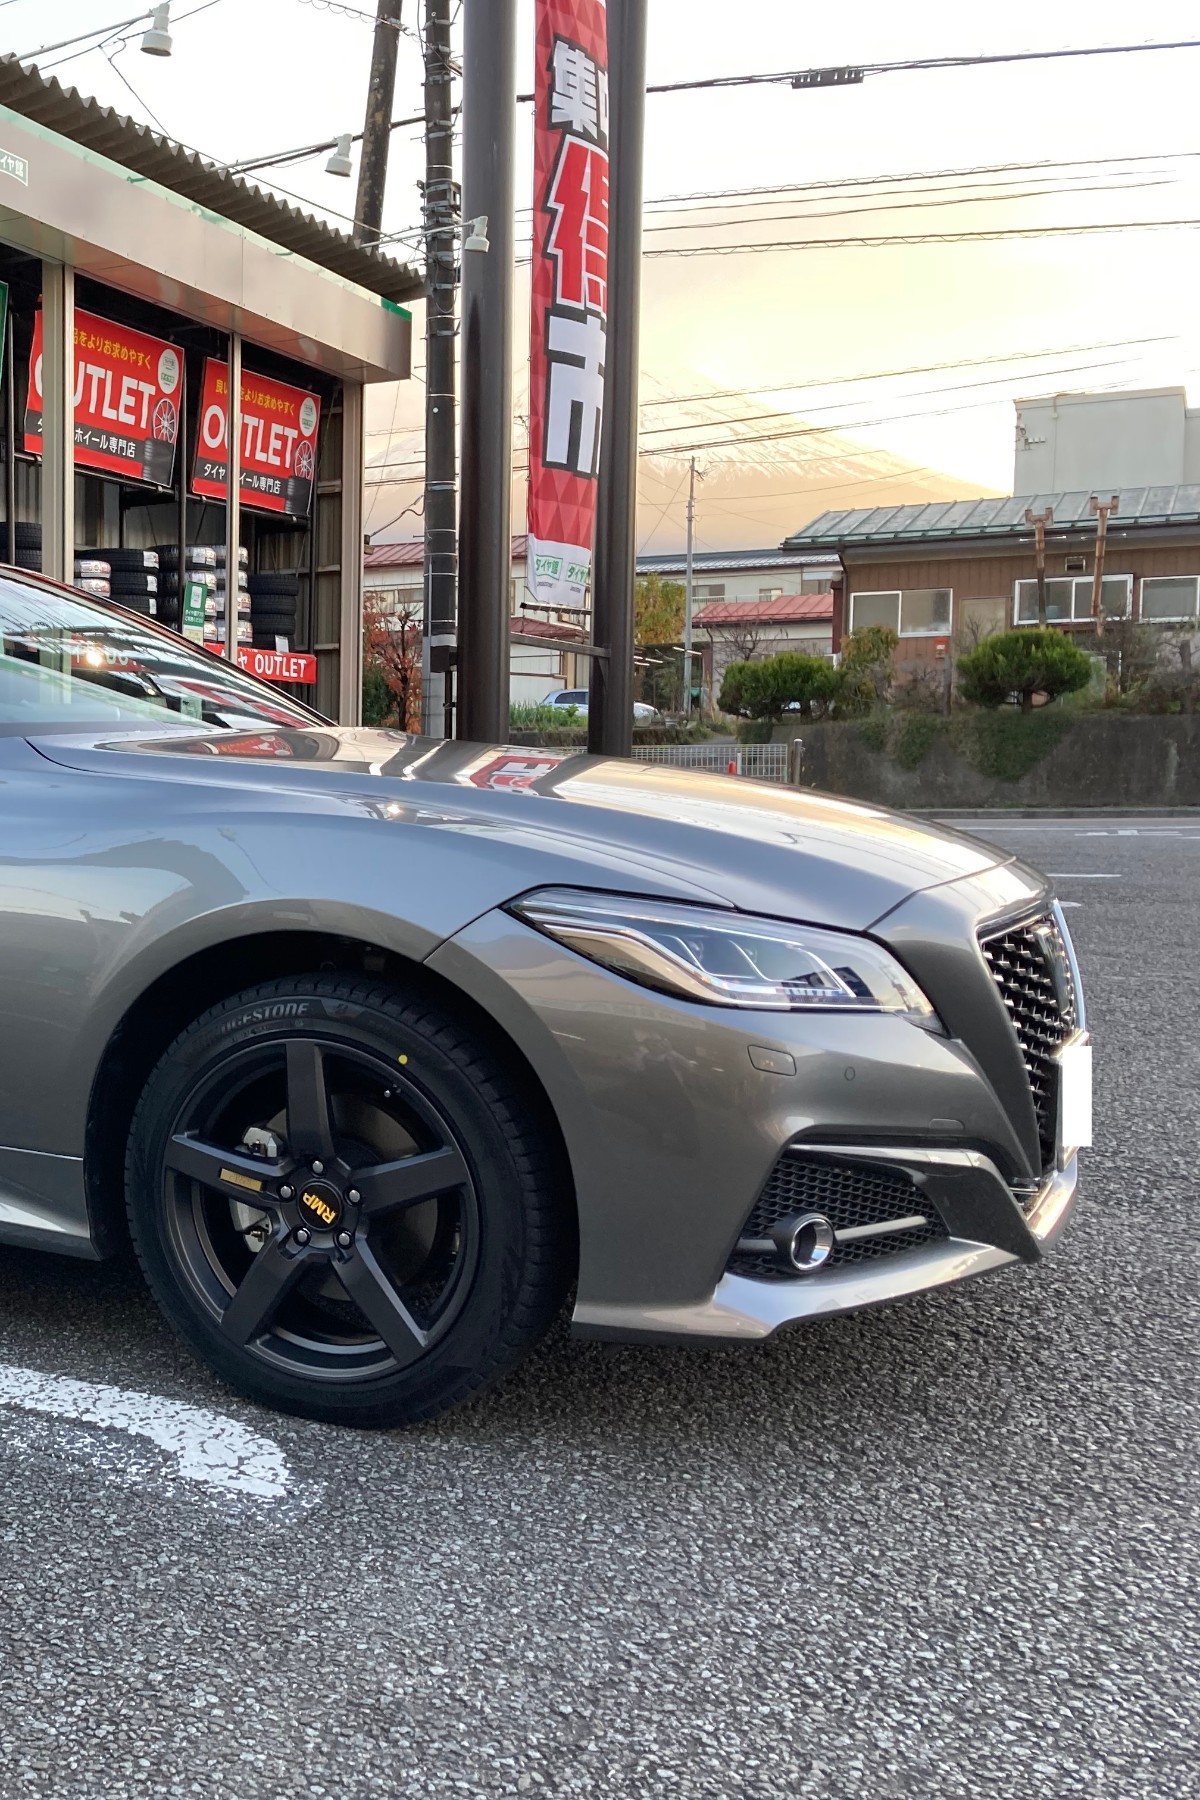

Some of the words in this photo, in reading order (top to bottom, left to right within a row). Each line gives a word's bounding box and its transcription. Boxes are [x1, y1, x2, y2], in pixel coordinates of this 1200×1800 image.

[35, 353, 156, 429] UTLET
[203, 404, 299, 468] OTLET
[255, 653, 307, 678] OUTLET
[303, 1192, 336, 1224] RMP
